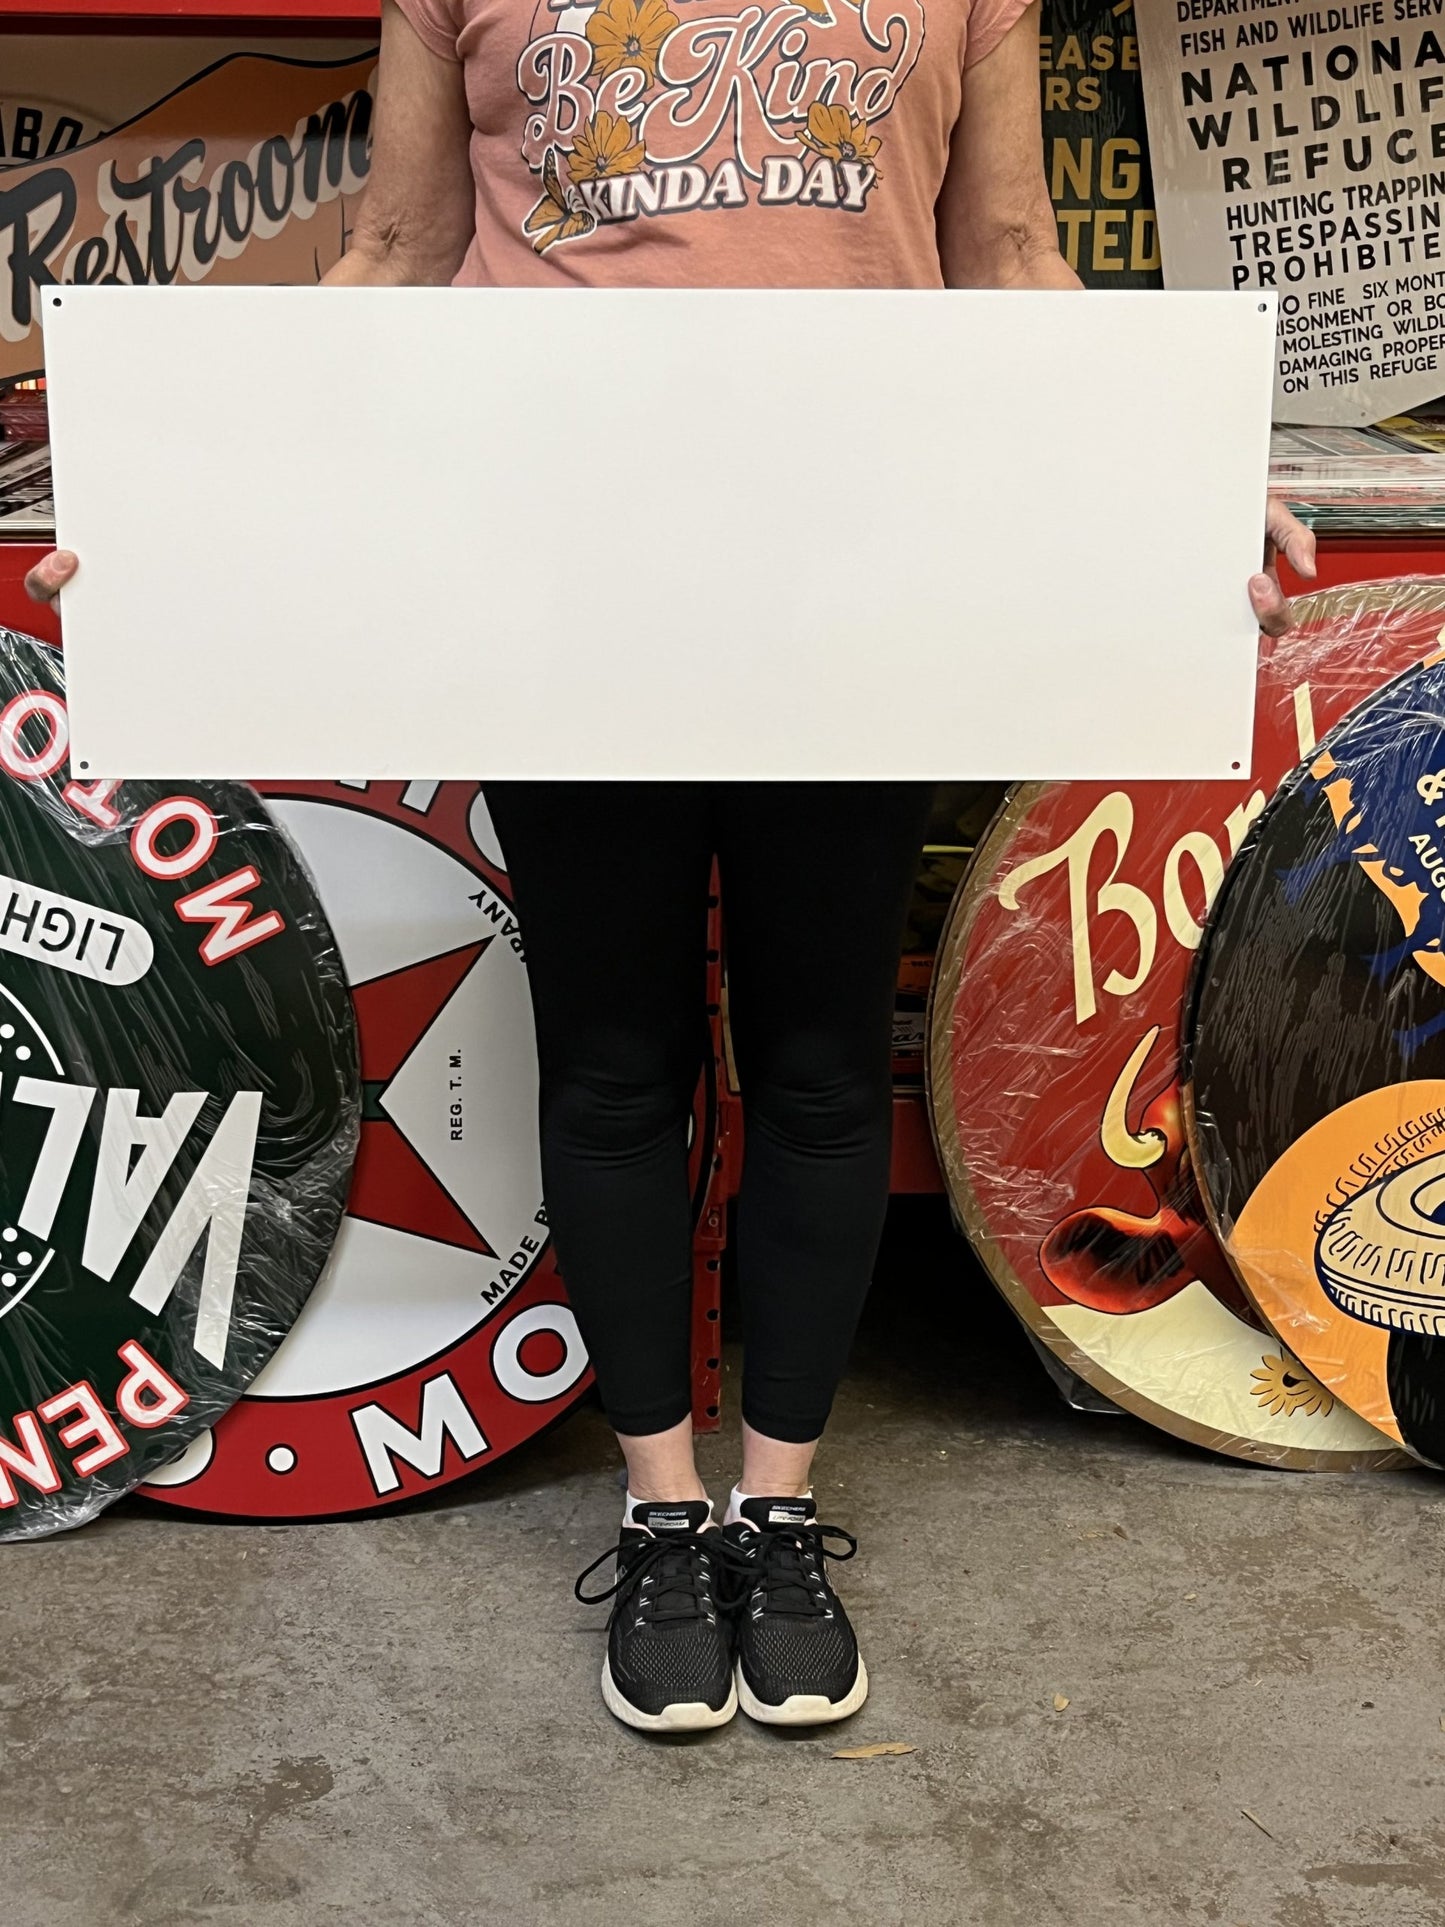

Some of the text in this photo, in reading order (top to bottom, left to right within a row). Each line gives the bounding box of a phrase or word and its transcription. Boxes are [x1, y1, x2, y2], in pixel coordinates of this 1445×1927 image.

[1177, 0, 1300, 22] DEPART
[1181, 28, 1225, 56] FISH
[1236, 20, 1278, 48] AND
[1288, 1, 1384, 38] WILDLIFE
[518, 0, 925, 178] Be Kind
[1181, 30, 1445, 106] NATIONA
[1187, 76, 1444, 150] WILDLIF
[1051, 138, 1141, 200] NG
[1222, 122, 1445, 193] REFUGE
[576, 155, 876, 224] KINDA DAY
[1226, 171, 1445, 231] HUNTING TRAPPIN
[1056, 210, 1162, 271] TED
[1230, 202, 1441, 261] TRESPASSIN
[1232, 232, 1441, 291] PROHIBITE
[1308, 287, 1346, 309] FINE
[1362, 280, 1389, 299] SIX
[1387, 299, 1413, 317] OR
[1279, 346, 1372, 376] DAMAGING
[1283, 324, 1383, 355] MOLESTING
[1282, 354, 1437, 394] ON THIS REFUGE
[1408, 833, 1445, 903] AUG
[0, 892, 125, 971] LIGH
[468, 889, 529, 964] PANY
[450, 1098, 463, 1141] REG.
[480, 1235, 540, 1306] MADE
